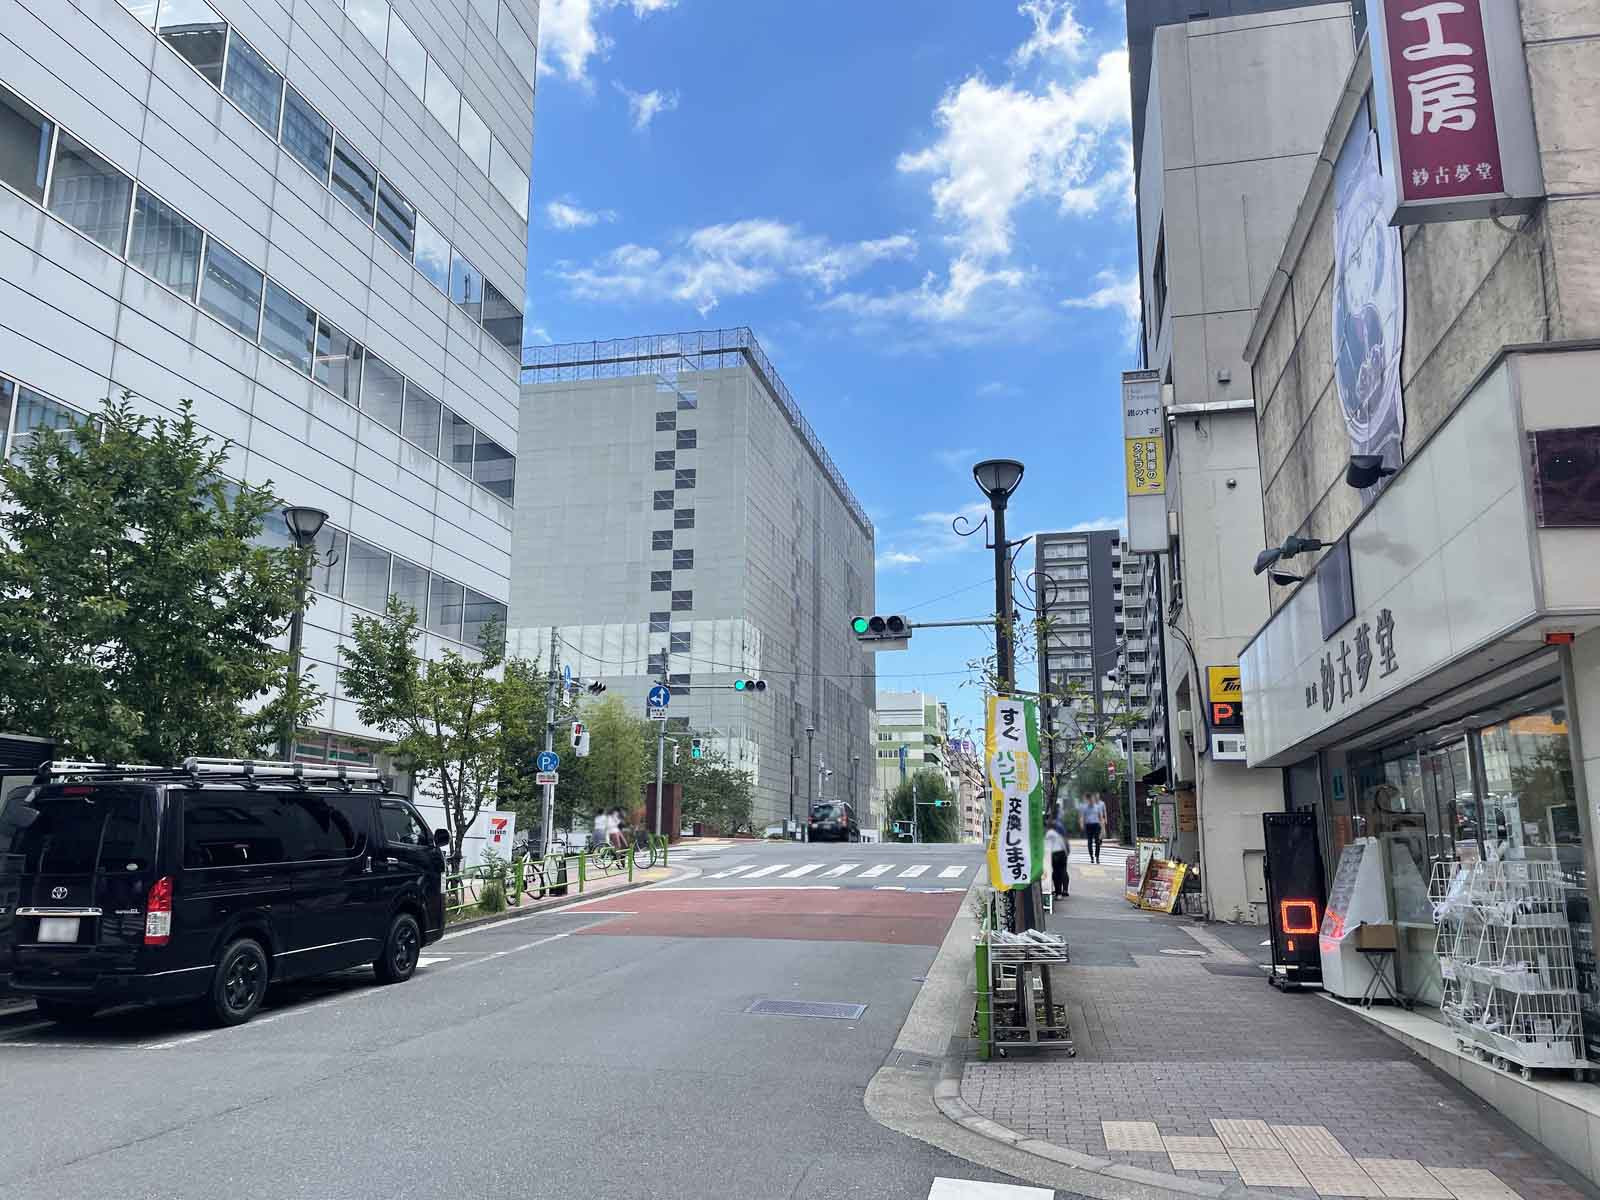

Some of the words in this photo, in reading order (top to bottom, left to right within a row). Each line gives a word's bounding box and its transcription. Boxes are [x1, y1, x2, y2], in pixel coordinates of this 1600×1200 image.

[1401, 2, 1477, 135] 工房
[1000, 708, 1019, 742] すぐ
[1213, 703, 1233, 725] P
